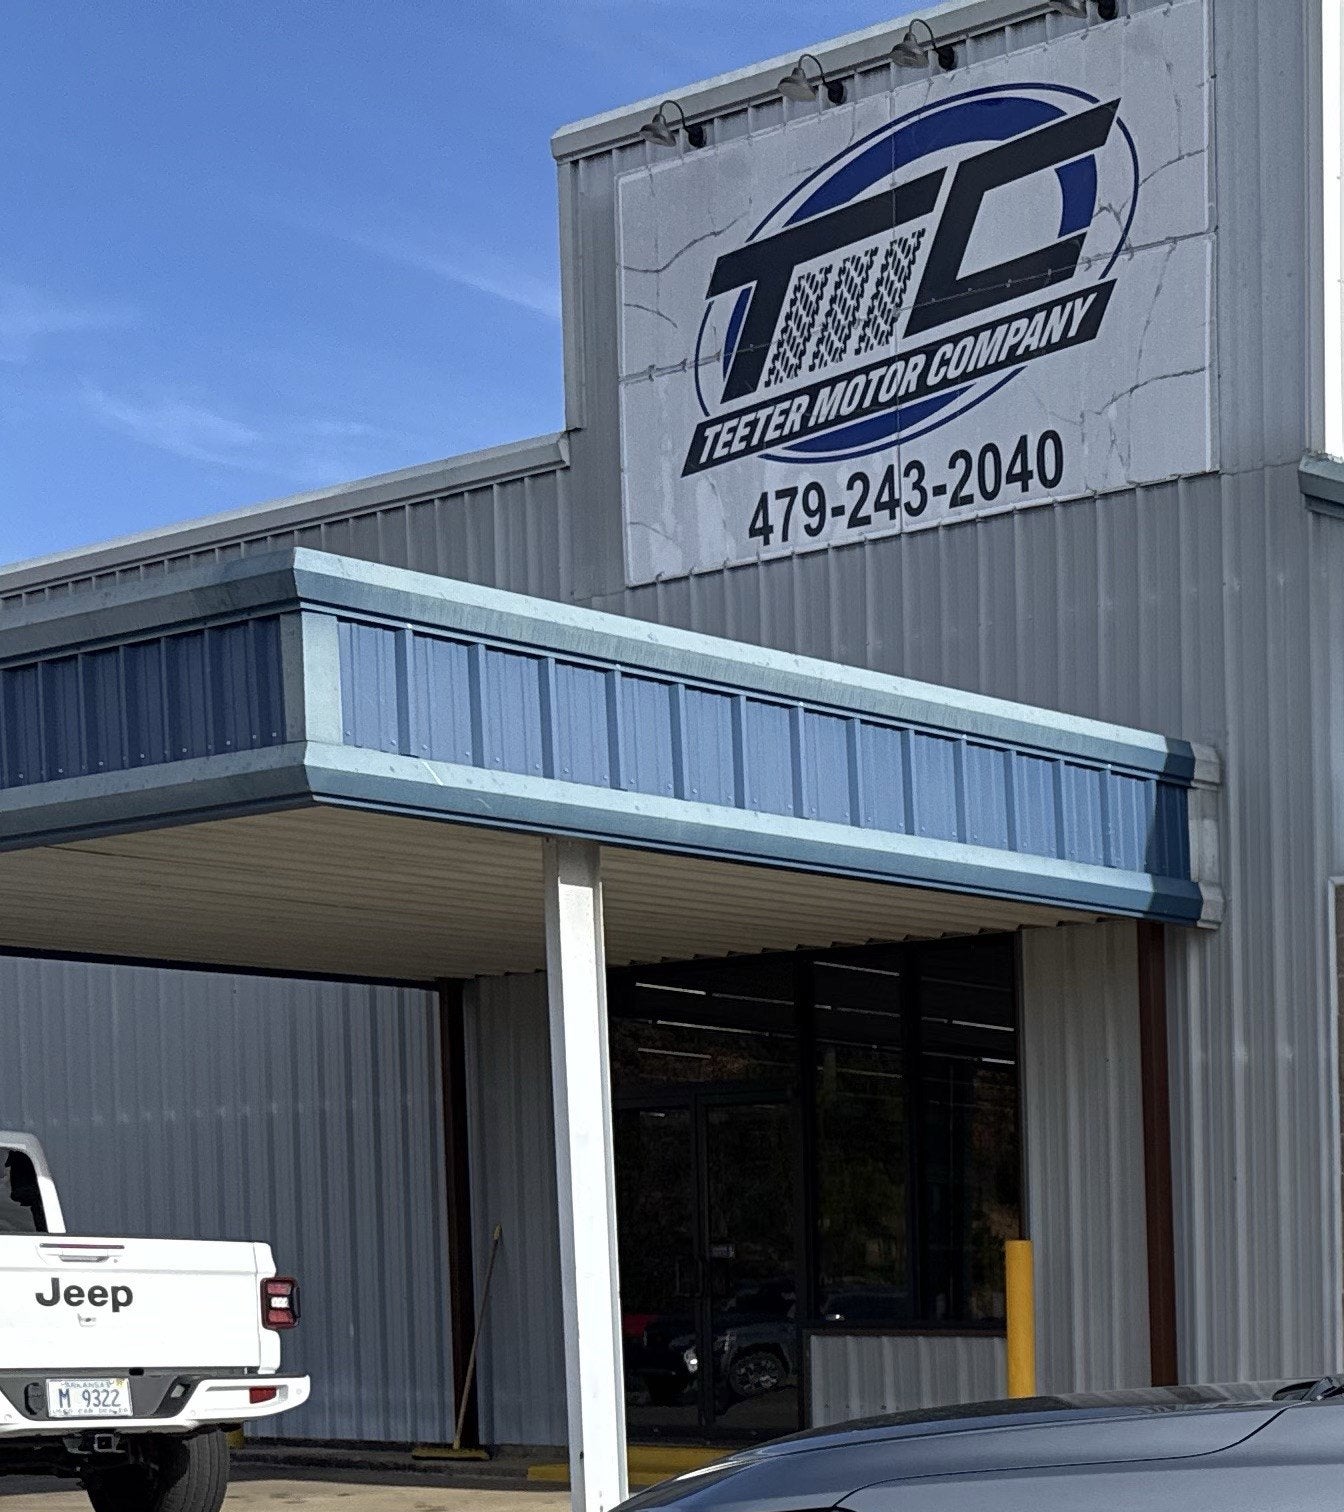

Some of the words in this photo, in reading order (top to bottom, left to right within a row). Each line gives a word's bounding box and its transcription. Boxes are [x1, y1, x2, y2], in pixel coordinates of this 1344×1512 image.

[699, 398, 810, 465] TEETER
[808, 354, 928, 429] MOTOR
[926, 293, 1099, 386] COMPANY
[748, 429, 1064, 546] 479-243-2040
[34, 1277, 134, 1313] Jeep
[58, 1388, 71, 1408] M
[82, 1389, 121, 1408] 9322
